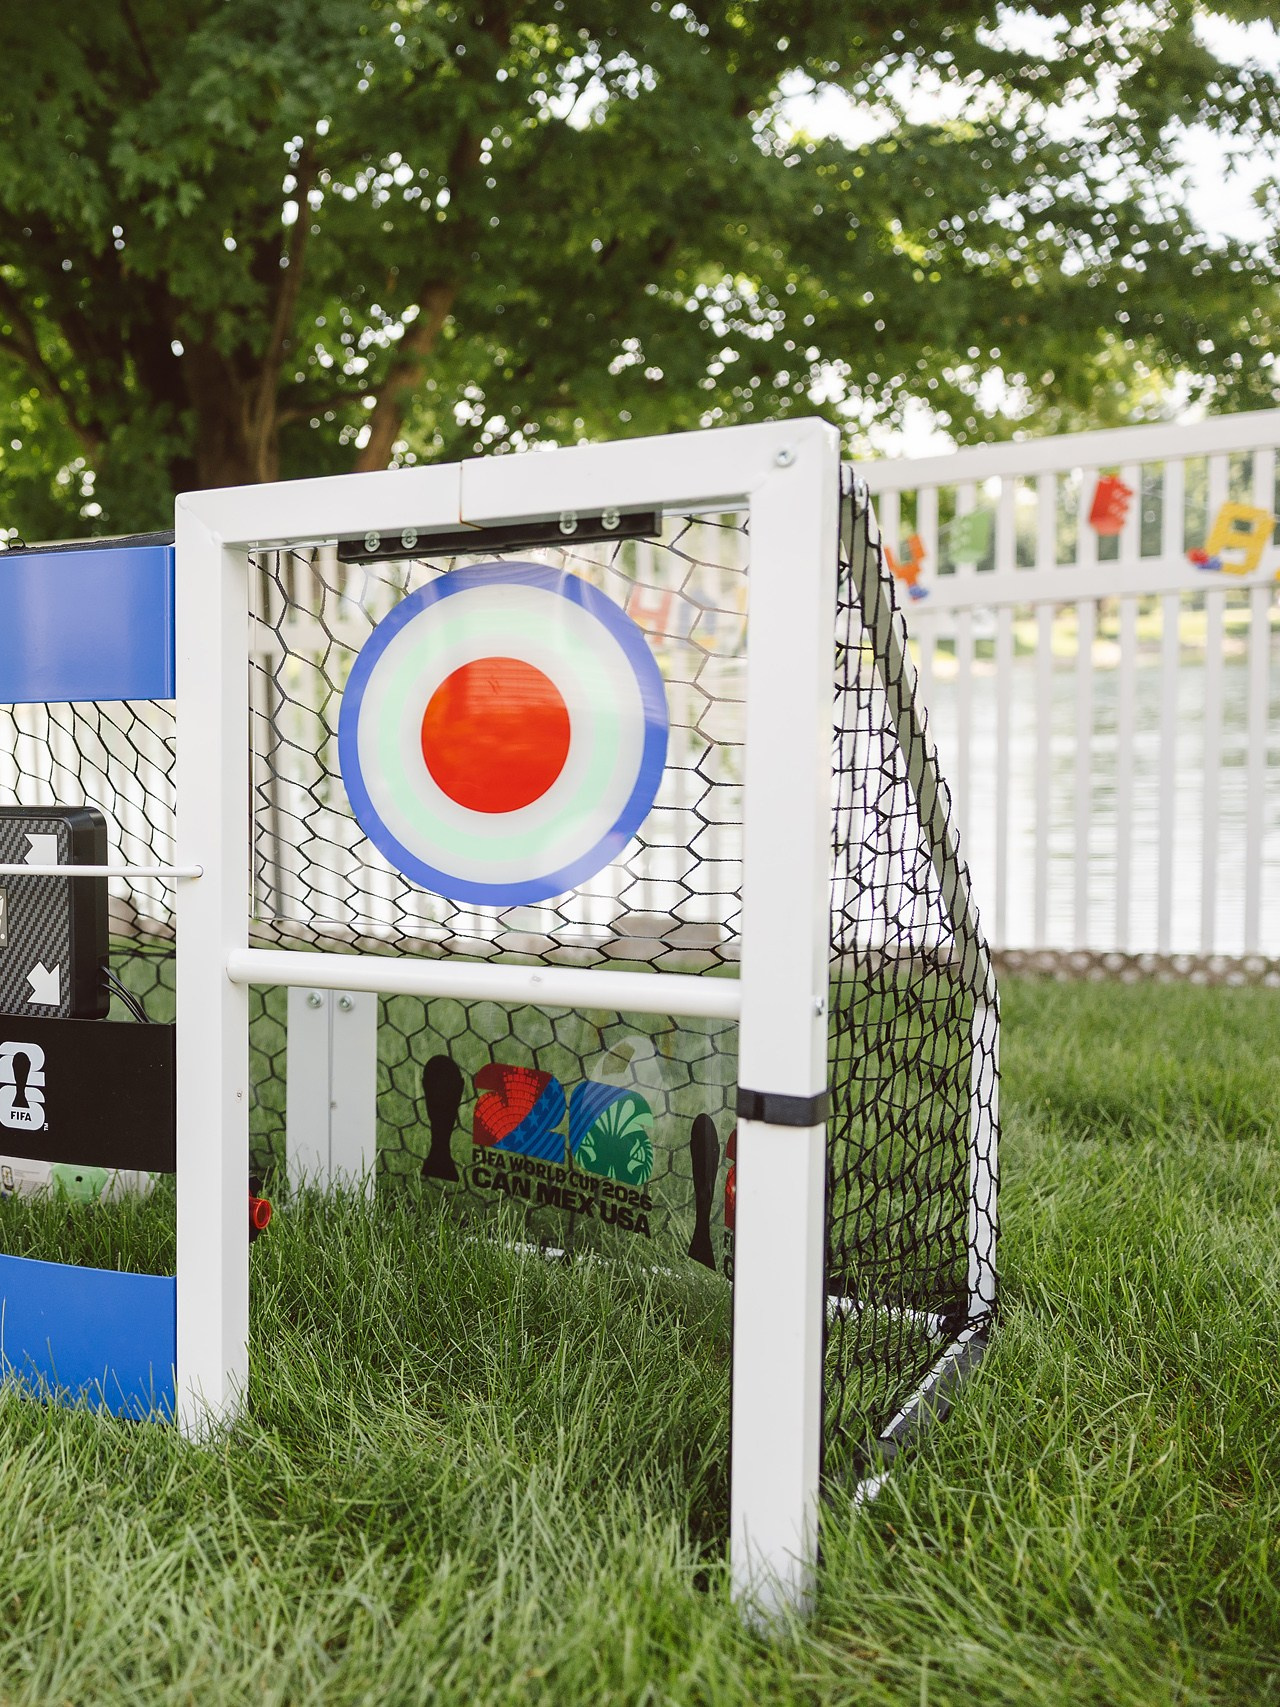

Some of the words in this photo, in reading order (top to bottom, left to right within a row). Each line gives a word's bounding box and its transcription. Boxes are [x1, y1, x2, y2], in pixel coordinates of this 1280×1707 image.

[10, 1110, 32, 1122] FIFA
[472, 1147, 506, 1170] FIFA
[509, 1155, 567, 1184] WORLD
[570, 1171, 599, 1193] CUP
[602, 1181, 653, 1212] 2026
[472, 1167, 531, 1200] CAN
[536, 1182, 595, 1218] MEX
[600, 1201, 652, 1239] USA
